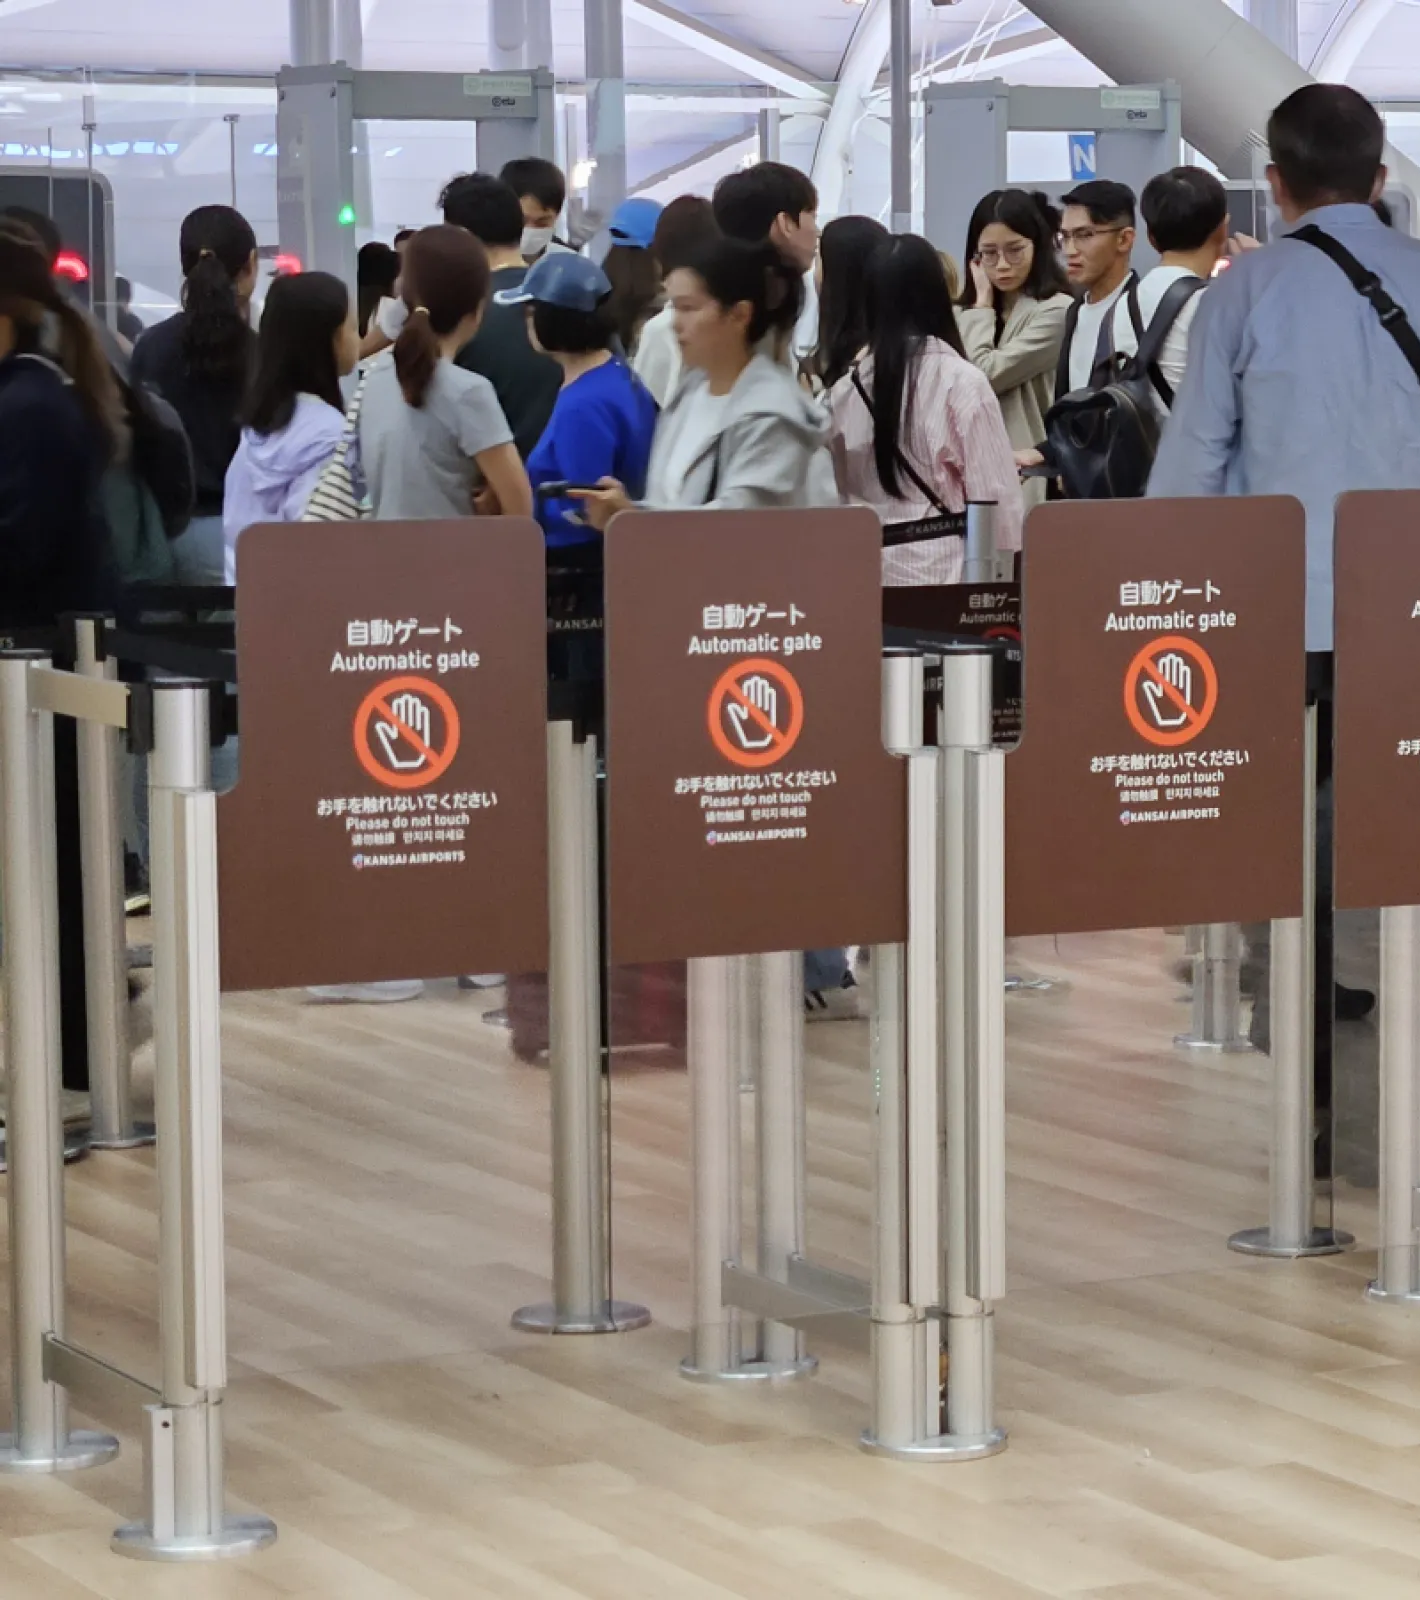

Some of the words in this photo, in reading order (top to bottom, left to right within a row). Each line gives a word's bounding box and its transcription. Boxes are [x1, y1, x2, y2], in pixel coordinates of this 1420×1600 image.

[1074, 143, 1096, 173] N
[969, 592, 1020, 609] 自動ゲー
[1120, 580, 1220, 606] 自動ゲート
[703, 604, 805, 629] 自動ゲート
[959, 611, 1014, 624] Automatic
[1105, 611, 1193, 631] Automatic
[1199, 611, 1236, 632] gate
[348, 618, 462, 645] 自動ゲート
[689, 634, 778, 654] Automatic
[783, 634, 821, 655] gate
[331, 650, 432, 671] Automatic
[437, 650, 479, 673] gate
[1090, 750, 1248, 773] お手を触れないでください
[675, 771, 836, 794] お手を触れないでください
[1117, 775, 1152, 786] Please
[1156, 774, 1170, 785] do
[1174, 773, 1190, 783] not
[1194, 770, 1223, 783] touch
[318, 792, 497, 815] お手を触れないでください
[701, 796, 739, 808] Please
[743, 795, 756, 804] do
[760, 794, 776, 803] not
[780, 791, 810, 803] touch
[346, 817, 391, 831] Please
[393, 817, 408, 827] do
[412, 815, 430, 826] not
[435, 813, 469, 825] touch
[1131, 812, 1168, 821] KANSAI
[1170, 808, 1220, 819] AIRPORTS
[717, 832, 754, 841] KANSAI
[757, 828, 806, 840] AIRPORTS
[364, 855, 406, 865] KANSAI
[410, 851, 465, 863] AIRPORTS
